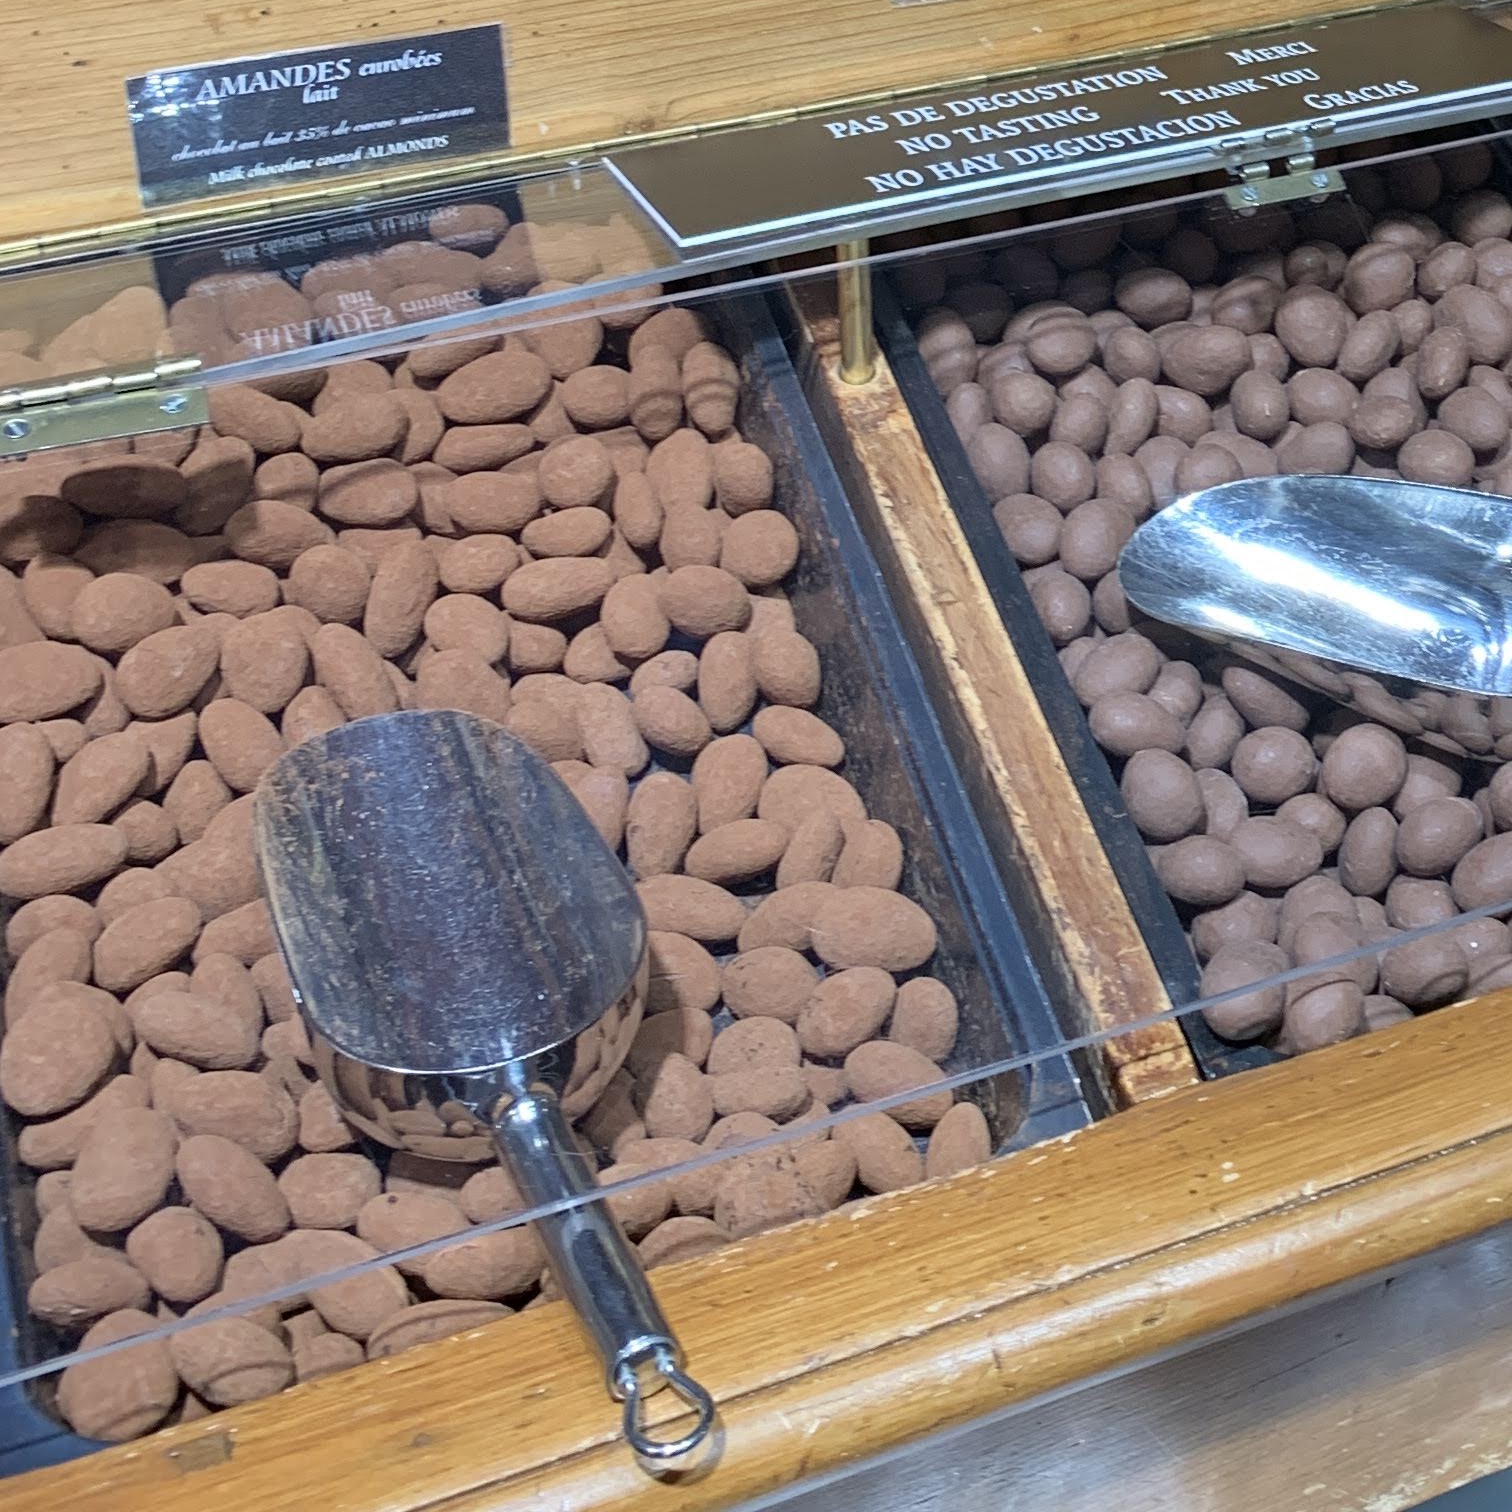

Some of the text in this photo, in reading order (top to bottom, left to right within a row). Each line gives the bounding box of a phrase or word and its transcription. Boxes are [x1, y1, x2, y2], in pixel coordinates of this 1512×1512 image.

[194, 57, 352, 102] AMANDES
[302, 83, 340, 105] lait
[823, 113, 890, 140] PAS
[889, 104, 947, 128] DE
[943, 65, 1169, 117] DEGUSTATION
[330, 119, 351, 137] de
[363, 134, 450, 160] ALMONDS
[894, 132, 953, 156] NO
[950, 104, 1101, 145] TASTING
[863, 167, 925, 194] NO
[923, 151, 1005, 182] HAY
[1002, 109, 1242, 167] DEGUSTACION
